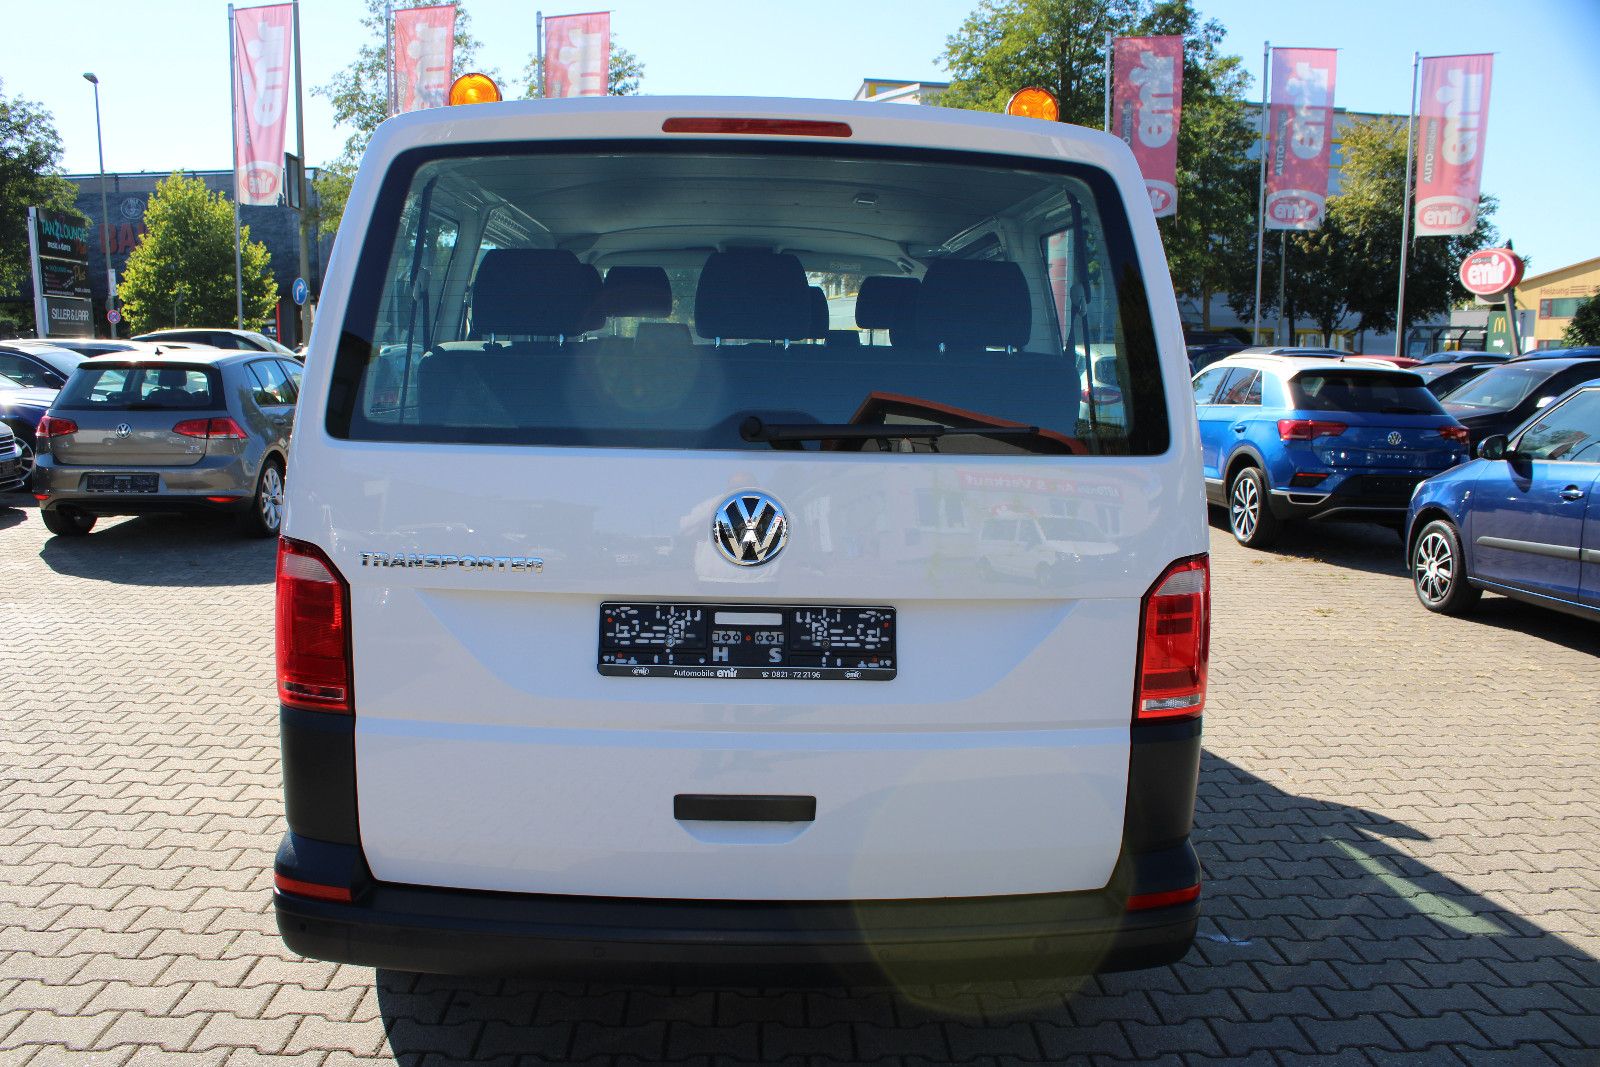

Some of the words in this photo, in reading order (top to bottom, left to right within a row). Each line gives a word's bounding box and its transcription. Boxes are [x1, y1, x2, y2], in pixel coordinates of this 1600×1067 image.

[559, 28, 602, 97] mir
[1129, 51, 1174, 148] emir
[1286, 62, 1328, 160] emir
[1436, 69, 1483, 165] emir
[1274, 200, 1312, 219] emir
[1424, 206, 1465, 225] emir
[98, 222, 144, 254] BA
[1468, 254, 1505, 286] emir
[360, 551, 545, 574] TRANSPORTER
[673, 669, 714, 677] Automobile
[716, 667, 738, 678] emir
